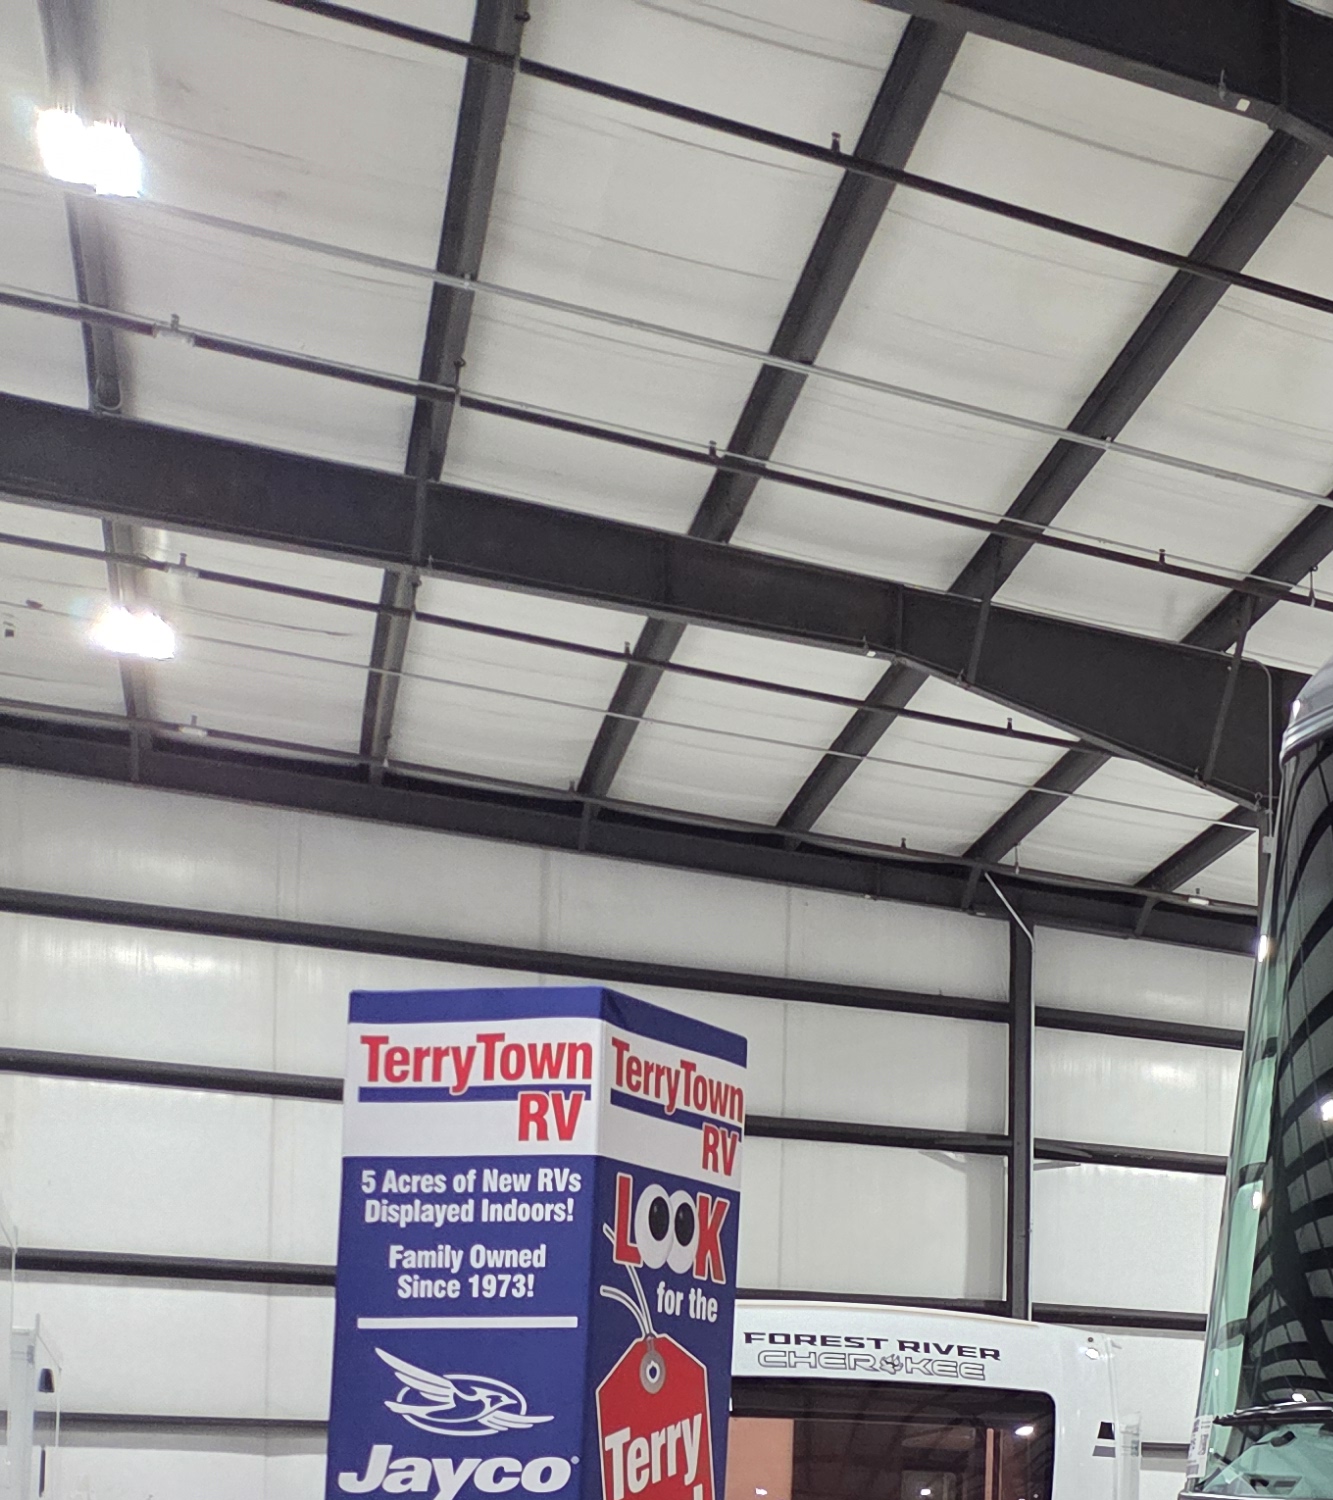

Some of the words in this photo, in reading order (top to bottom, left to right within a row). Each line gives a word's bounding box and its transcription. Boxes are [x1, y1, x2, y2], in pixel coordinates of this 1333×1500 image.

[360, 1032, 593, 1093] TerryTown
[611, 1036, 744, 1124] TerryTown
[518, 1092, 584, 1142] RV
[701, 1123, 740, 1177] RV
[361, 1169, 377, 1194] 5
[381, 1169, 447, 1194] Acres
[452, 1169, 477, 1193] of
[482, 1168, 532, 1193] New
[537, 1167, 582, 1193] RVs
[364, 1198, 475, 1228] Displayed
[481, 1197, 575, 1223] Indoors!
[388, 1243, 464, 1274] Family
[469, 1243, 547, 1269] Owned
[397, 1273, 461, 1299] Since
[468, 1273, 535, 1298] 1973!
[656, 1280, 684, 1316] for
[688, 1287, 718, 1323] the
[743, 1331, 889, 1350] FOREST
[896, 1339, 1001, 1361] RIVER
